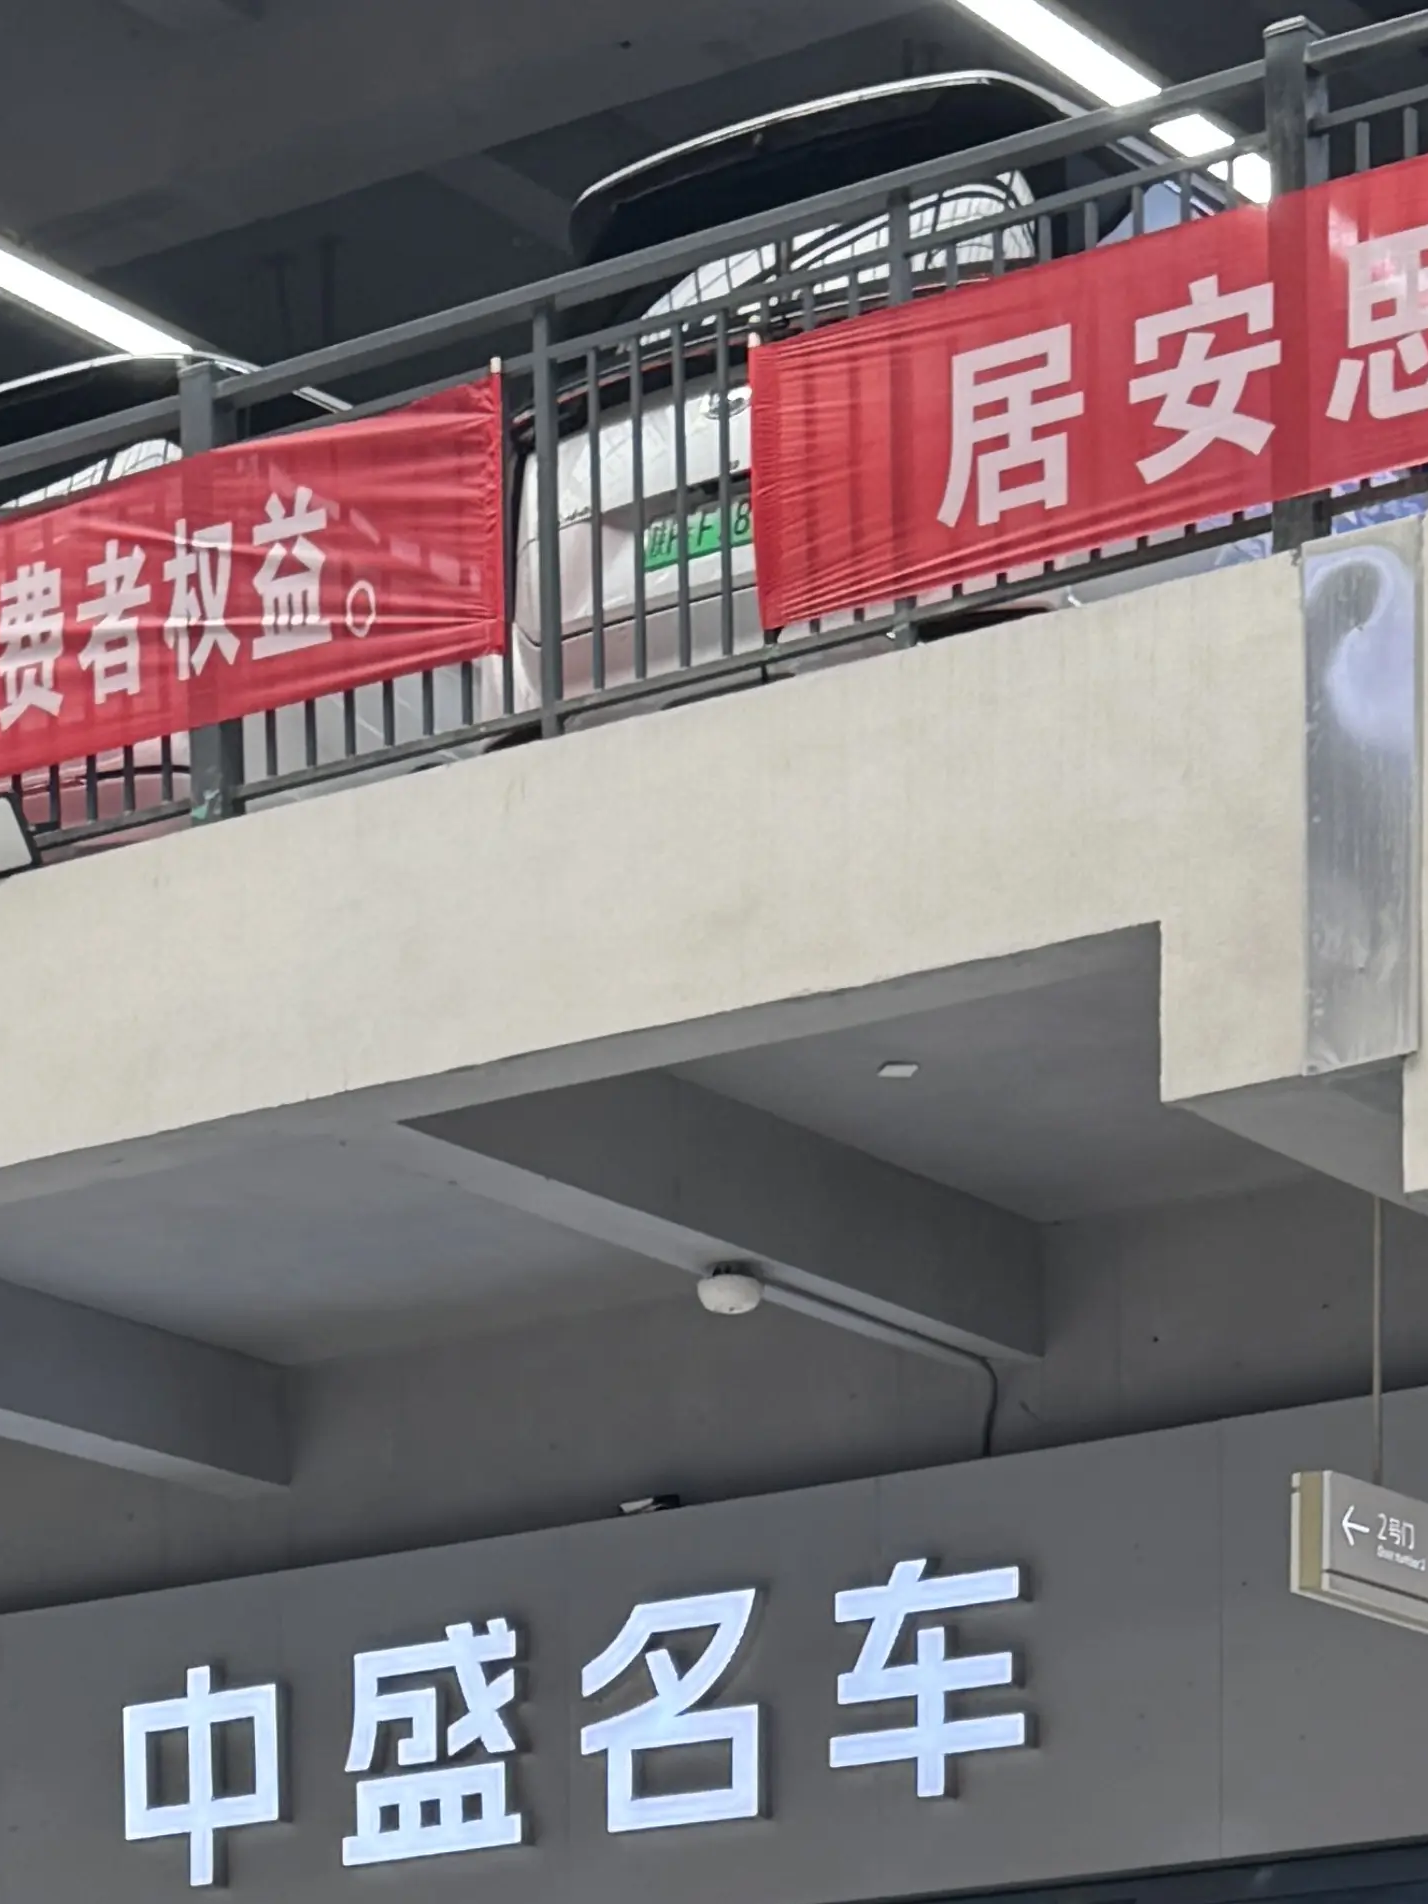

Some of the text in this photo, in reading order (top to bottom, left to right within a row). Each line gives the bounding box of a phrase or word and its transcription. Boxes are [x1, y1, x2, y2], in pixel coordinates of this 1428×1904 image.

[1376, 1512, 1416, 1551] 2号门
[123, 1558, 1026, 1887] 中盛名车
